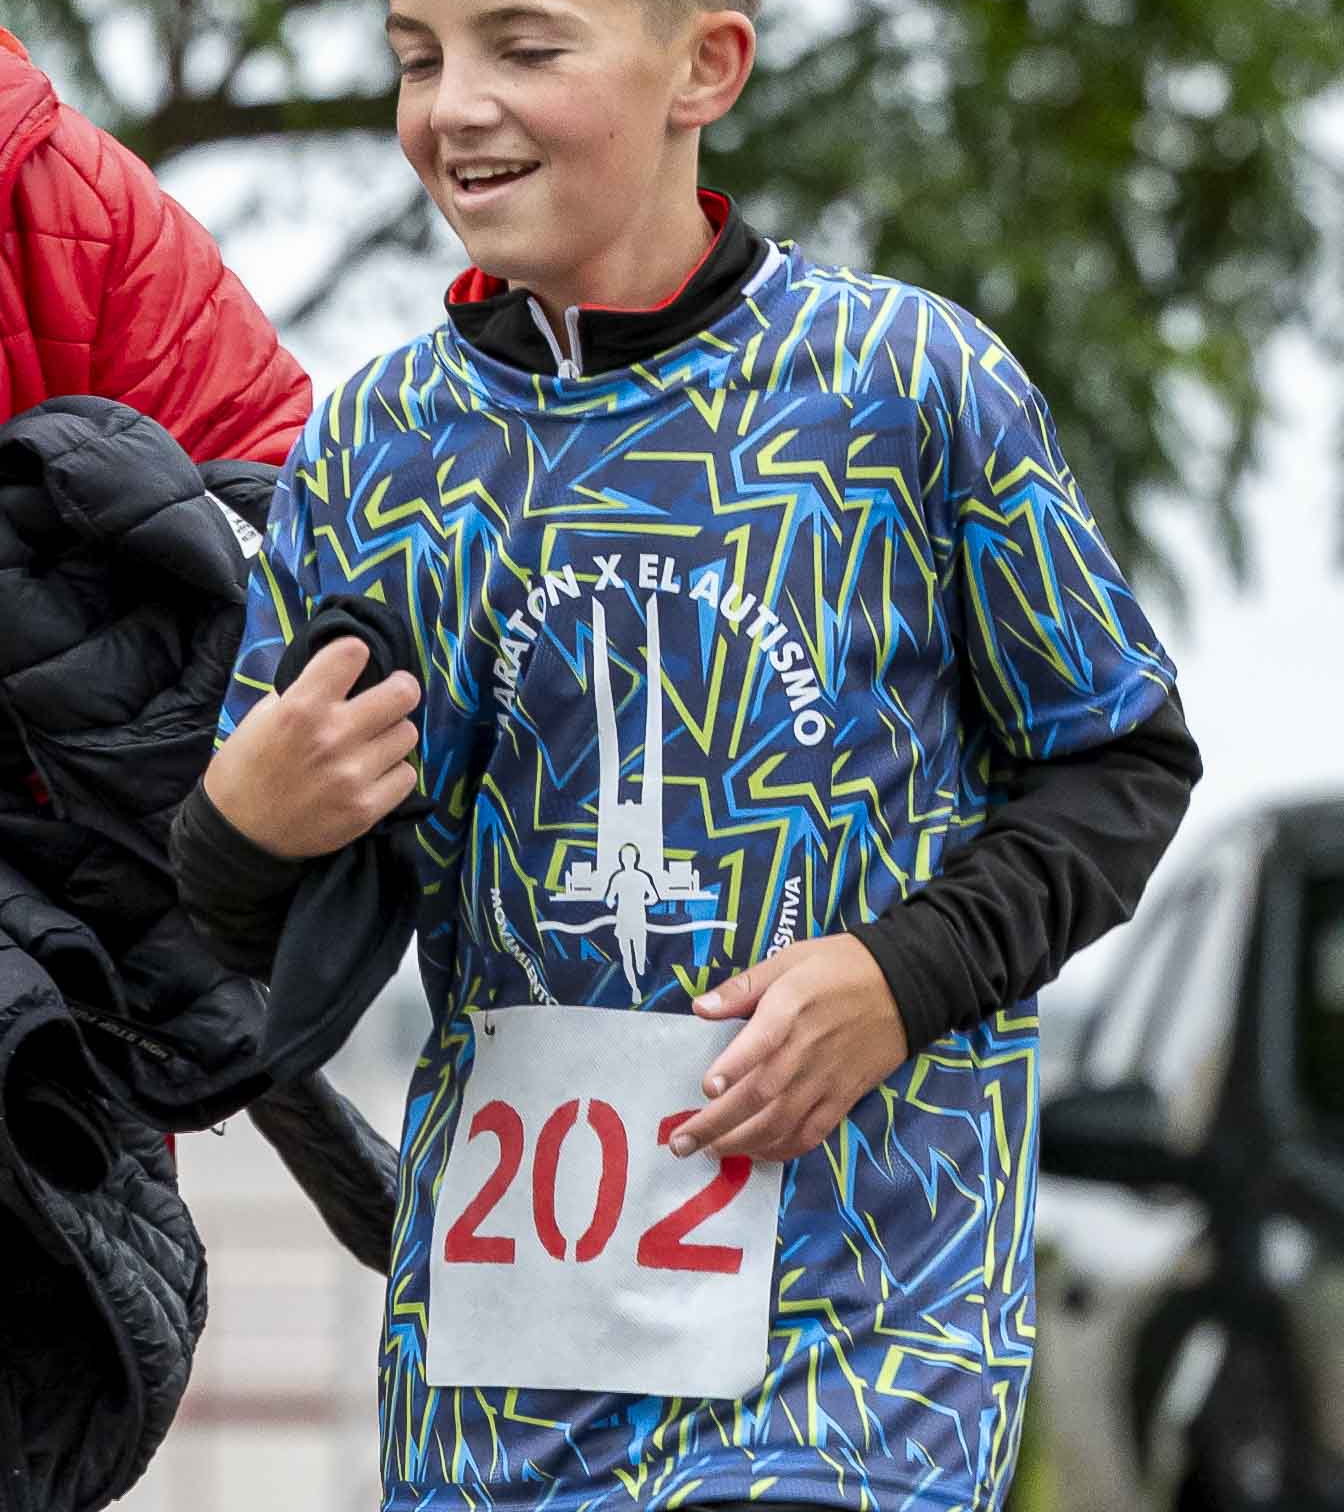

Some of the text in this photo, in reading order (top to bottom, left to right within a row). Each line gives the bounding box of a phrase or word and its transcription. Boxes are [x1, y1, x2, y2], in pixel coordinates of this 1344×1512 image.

[592, 554, 625, 591] X
[638, 553, 681, 594] EL
[688, 570, 826, 746] AUTISMO
[444, 1098, 754, 1274] 202
